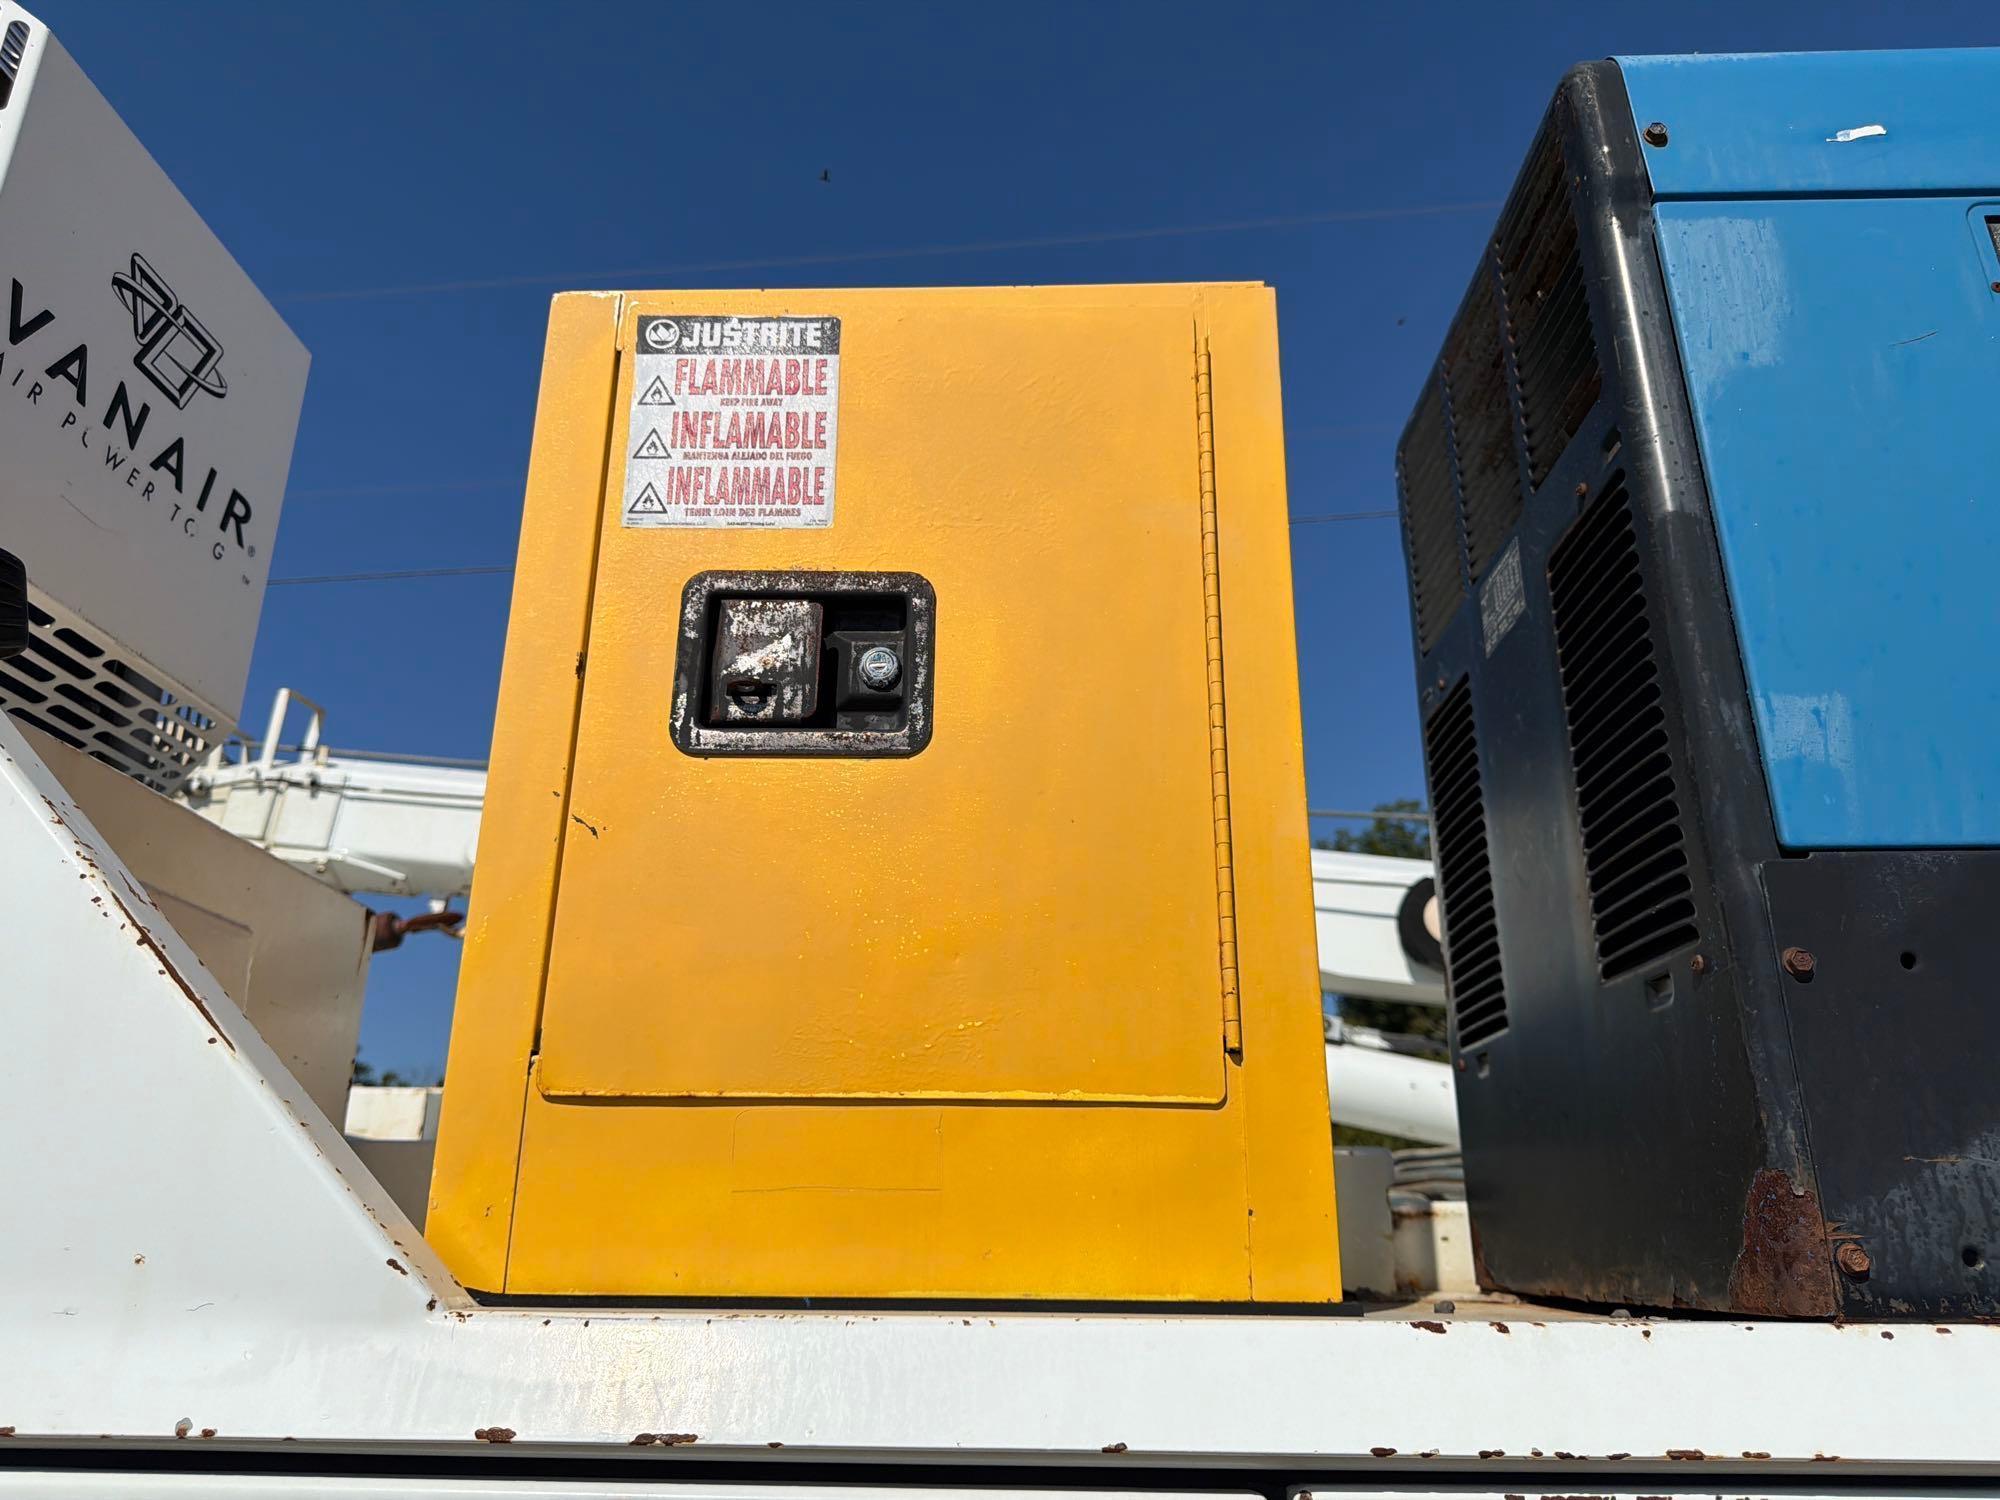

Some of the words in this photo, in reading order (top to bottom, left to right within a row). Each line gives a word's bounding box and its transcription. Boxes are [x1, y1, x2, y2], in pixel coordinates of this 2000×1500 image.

[682, 319, 822, 349] JUSTRITE
[674, 358, 828, 396] FLAMMABLE
[720, 398, 739, 407] KEEP
[741, 398, 759, 407] FIRE
[761, 398, 784, 407] AWAY
[670, 411, 827, 450] INFLAMABLE
[731, 451, 768, 461] ALEJADO
[769, 451, 785, 461] DEL
[786, 451, 813, 461] FUEGO
[666, 465, 826, 506] INFLAMMABLE
[684, 507, 712, 517] TENIR
[714, 507, 737, 517] LOIN
[738, 507, 756, 517] DES
[757, 507, 801, 517] FLAMMES
